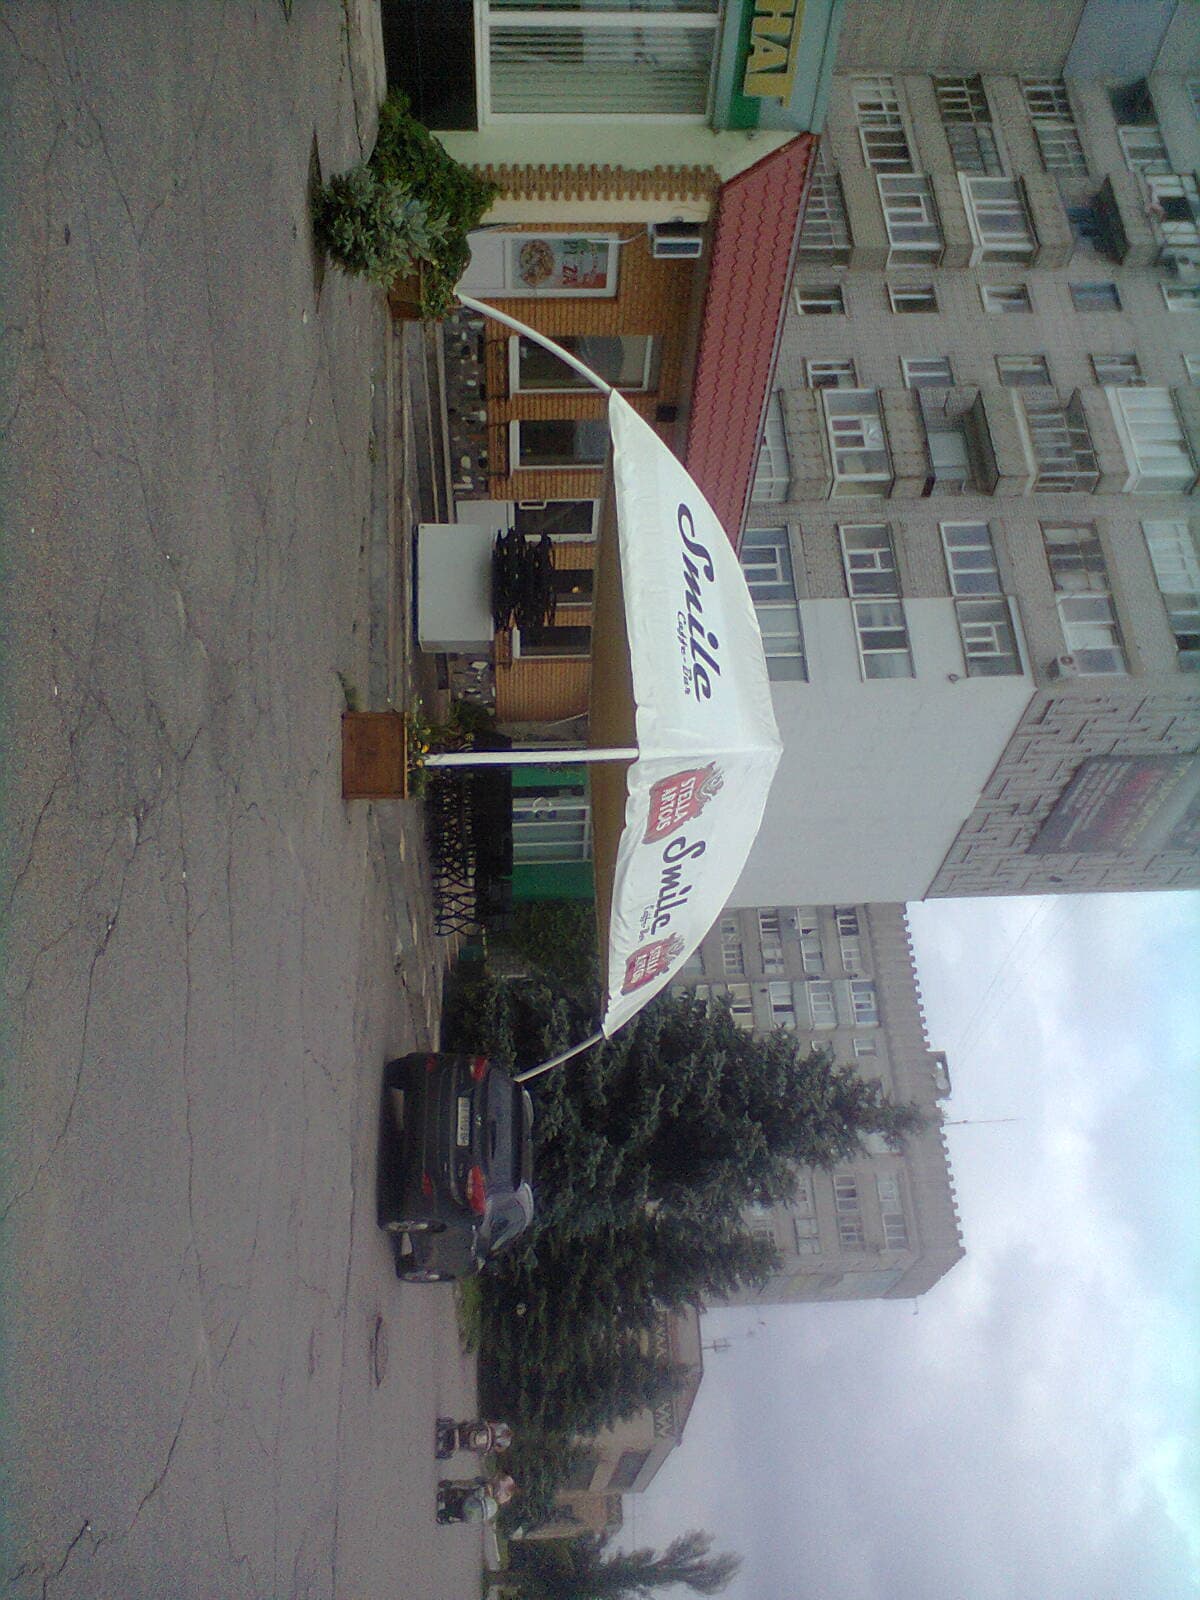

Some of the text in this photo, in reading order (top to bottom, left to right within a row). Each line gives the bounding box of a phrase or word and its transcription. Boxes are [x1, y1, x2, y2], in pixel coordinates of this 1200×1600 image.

[562, 240, 578, 285] PIZA
[678, 503, 721, 702] Smile
[655, 786, 678, 833] ARTOIS
[672, 776, 696, 822] STELLA
[650, 837, 706, 935] Smile
